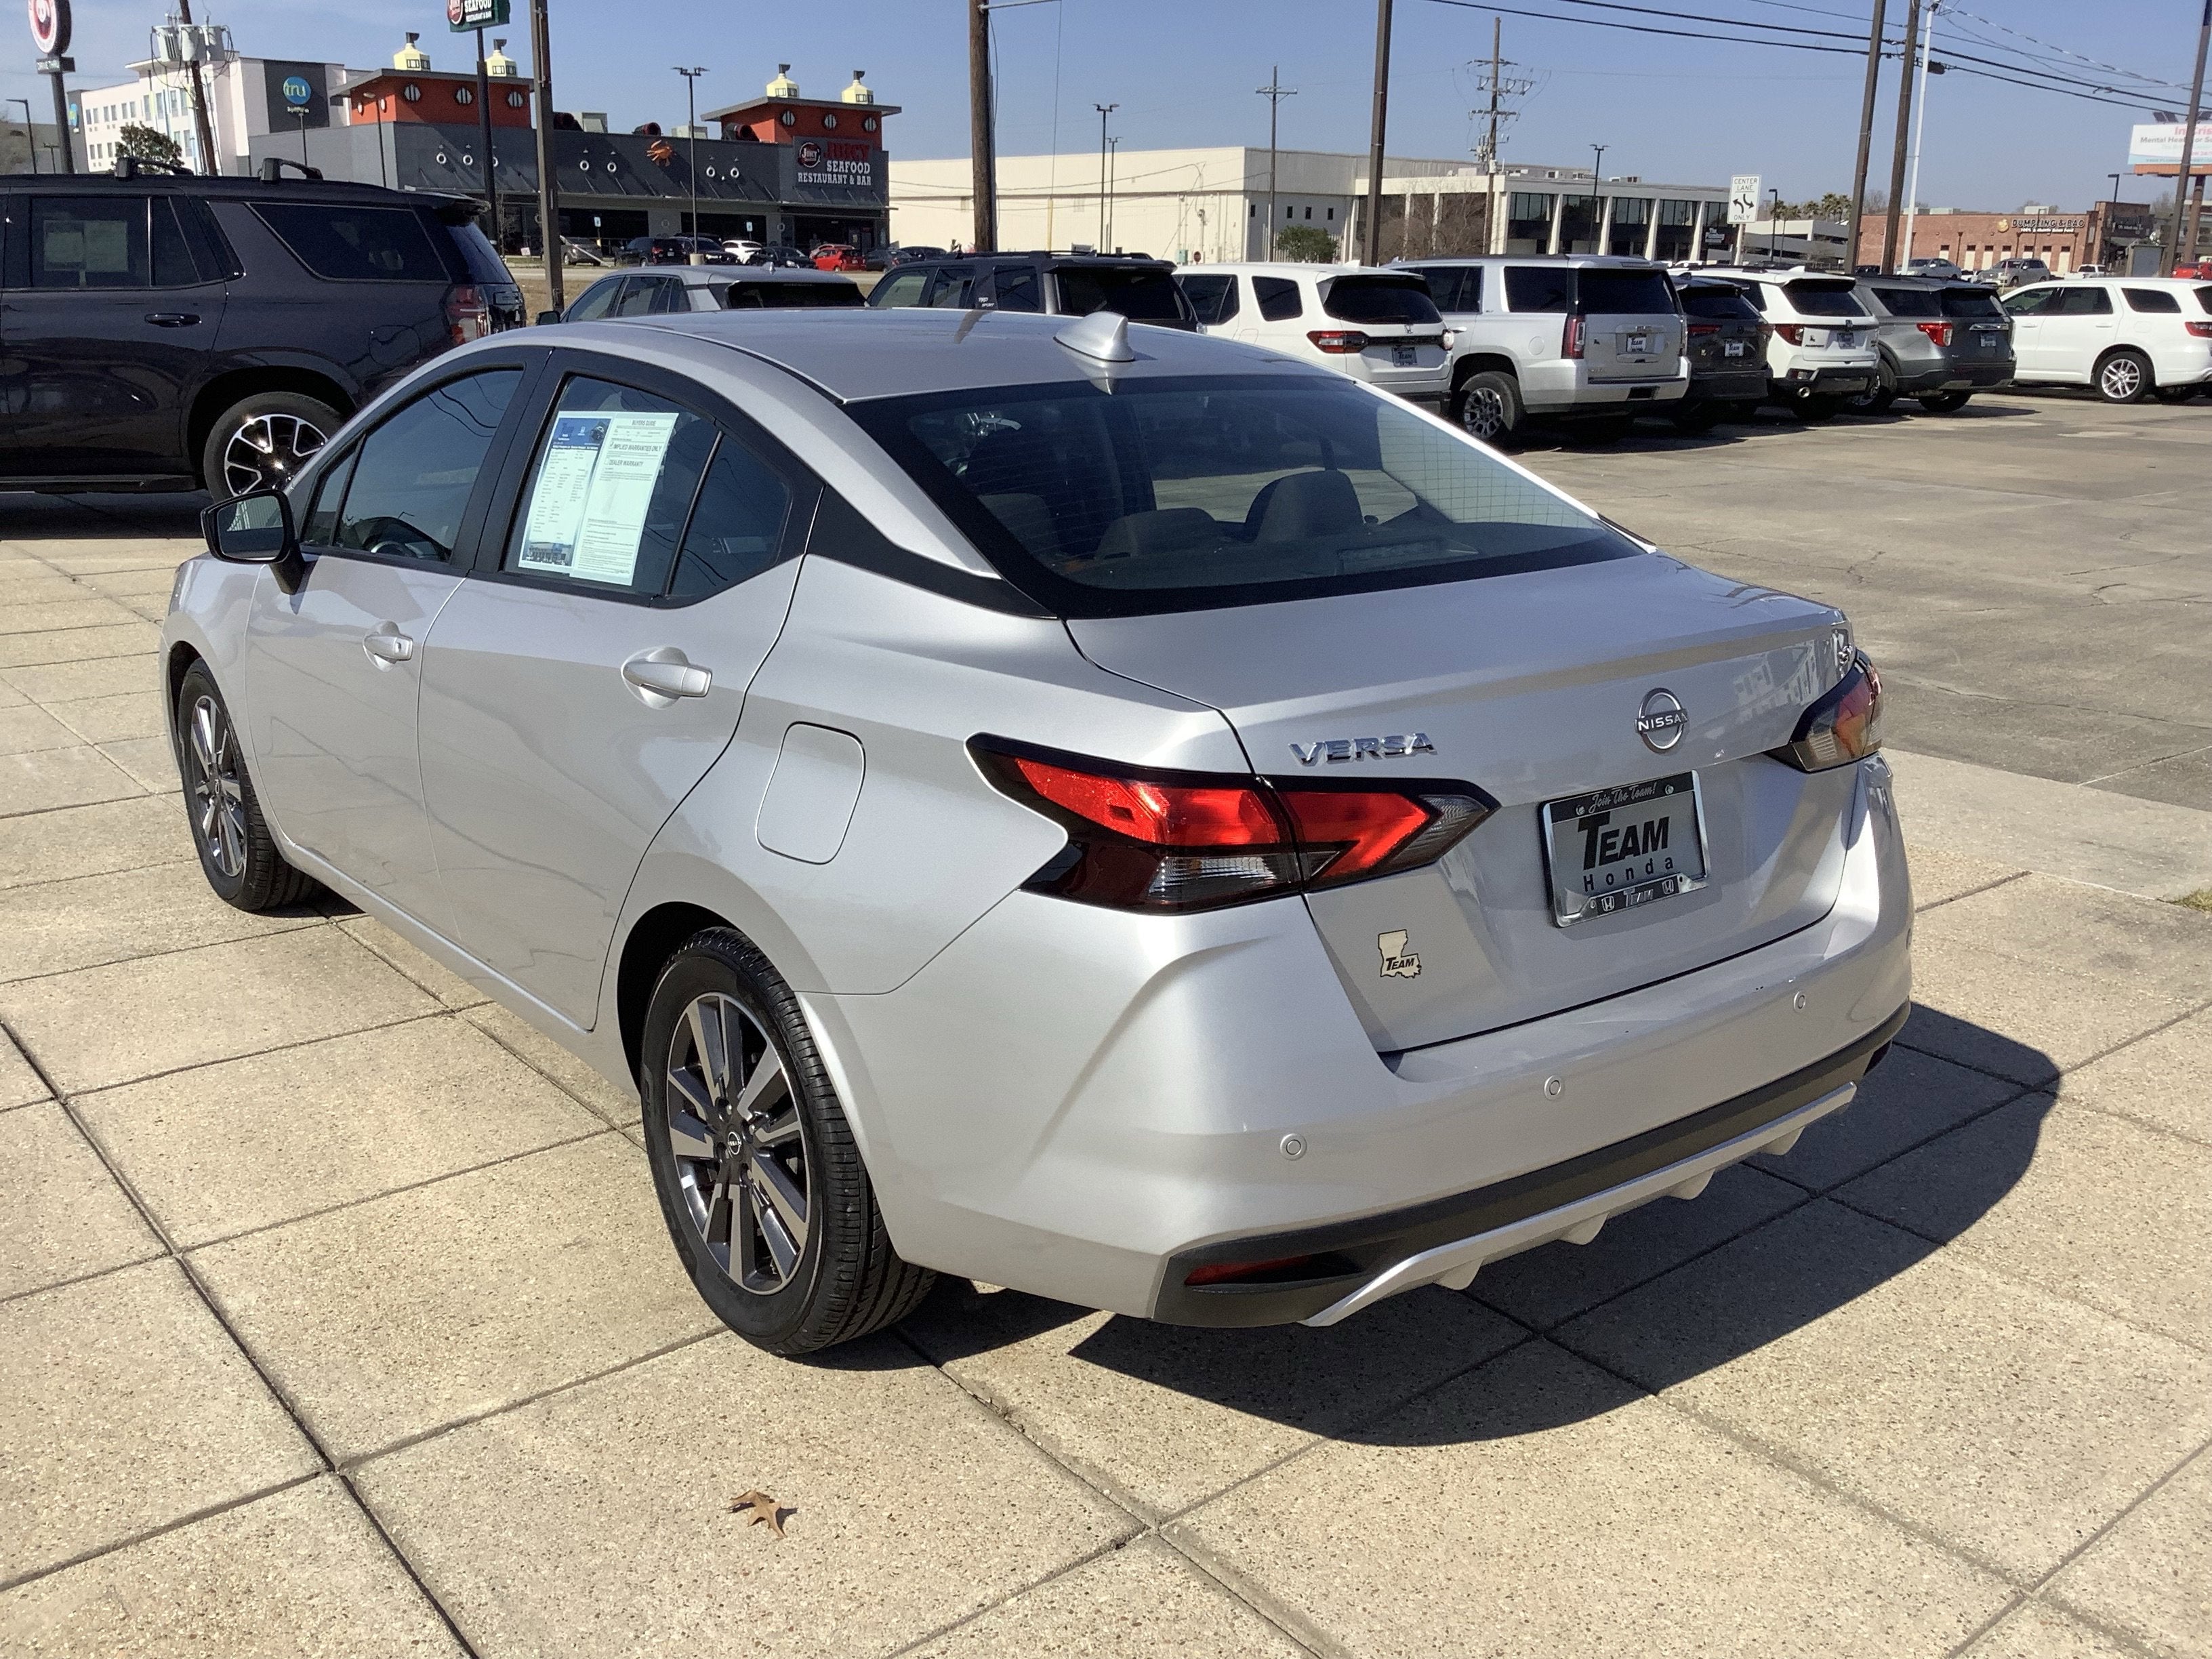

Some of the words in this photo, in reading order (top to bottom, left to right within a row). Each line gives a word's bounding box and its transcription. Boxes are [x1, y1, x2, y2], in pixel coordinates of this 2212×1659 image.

[464, 0, 491, 13] SEAFOOD
[827, 160, 870, 174] SEAFOOD
[798, 172, 847, 184] RESTAURANT
[849, 175, 855, 185] &
[857, 176, 872, 186] BAR
[2067, 219, 2085, 227] BAO
[1637, 712, 1688, 731] NISSAN
[1288, 733, 1438, 767] VERSA
[1588, 794, 1612, 814] Join
[1612, 788, 1629, 804] The
[1629, 781, 1657, 800] Team!
[1578, 811, 1670, 871] TEAM
[1583, 856, 1674, 893] Honda
[1386, 956, 1415, 971] TEAM
